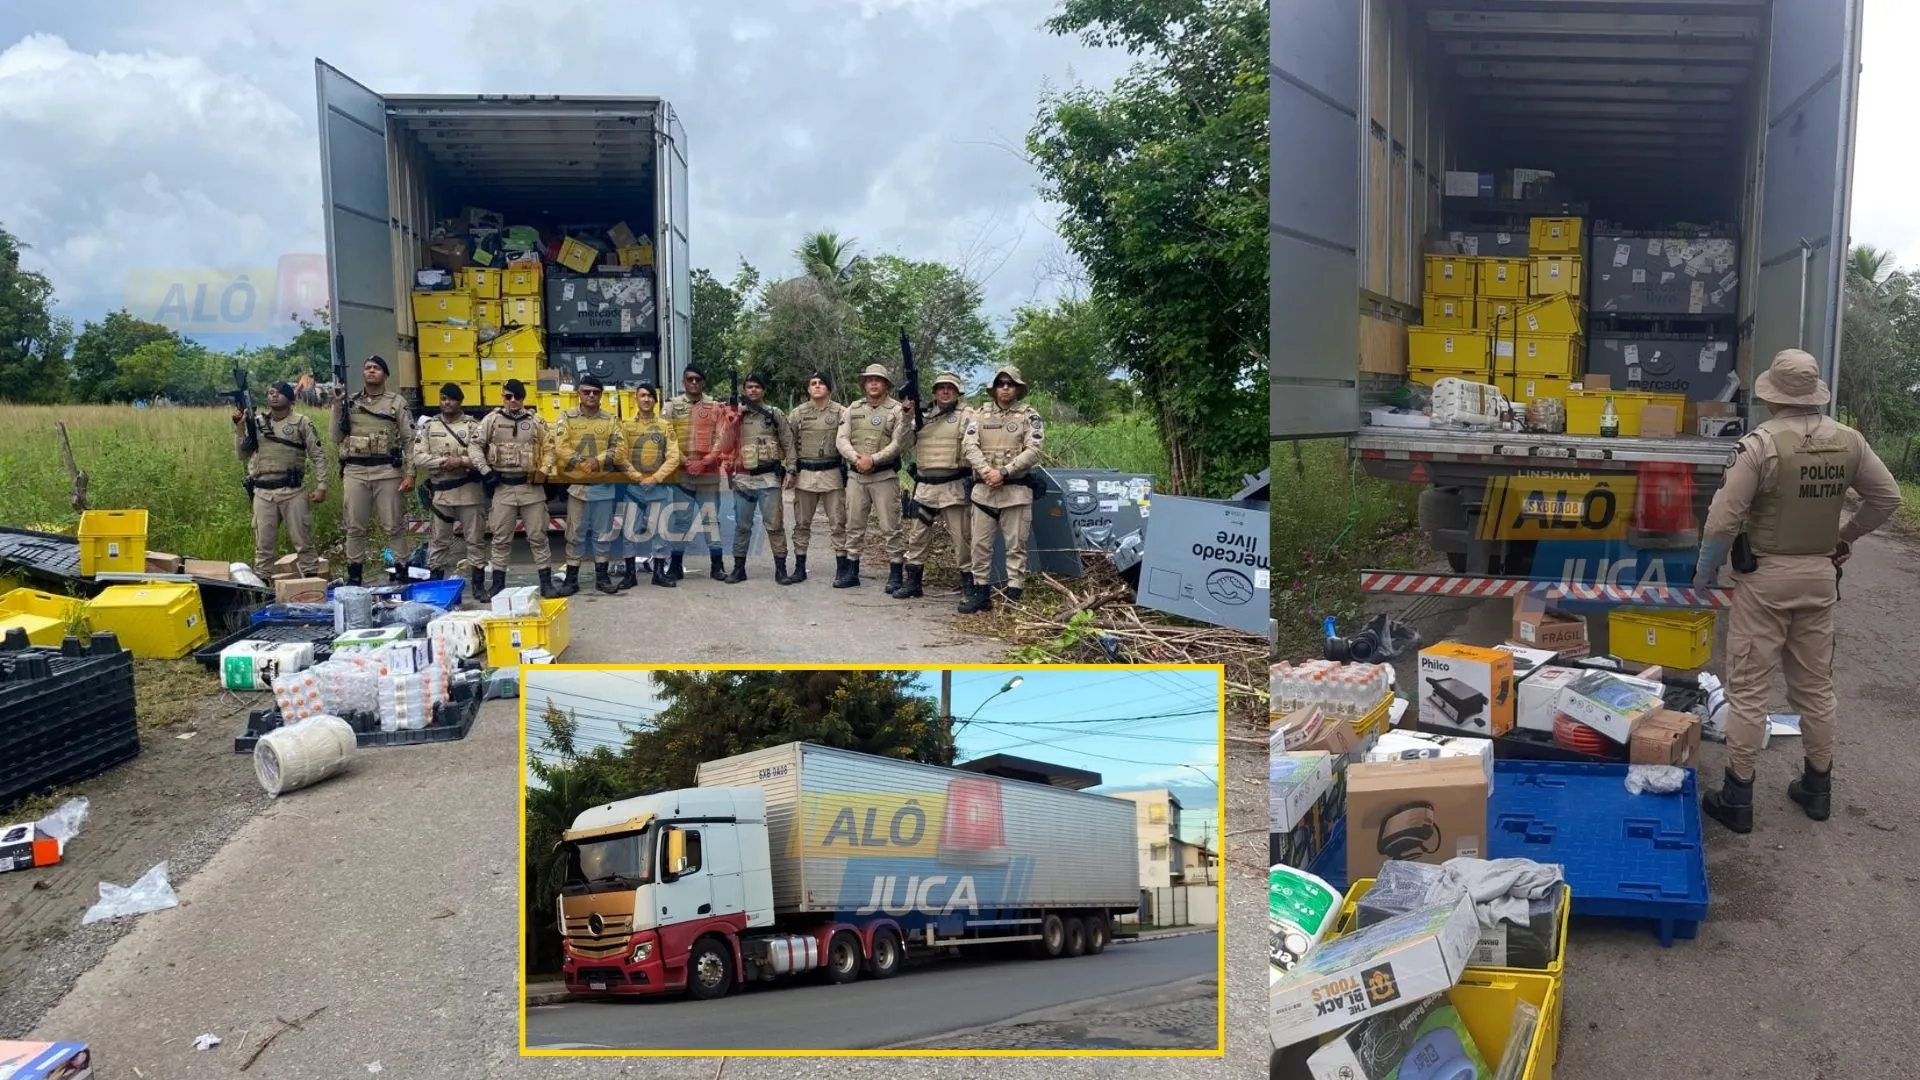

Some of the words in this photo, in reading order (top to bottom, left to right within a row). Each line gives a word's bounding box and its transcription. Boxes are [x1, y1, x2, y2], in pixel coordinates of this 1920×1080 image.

[1800, 463, 1845, 480] POLÍCIA
[1799, 484, 1843, 498] MILITAR
[1216, 530, 1258, 553] livre
[1541, 631, 1582, 645] FRÁGIL
[1421, 657, 1450, 671] Philco
[1311, 975, 1361, 1002] TOOLS
[1316, 989, 1364, 1017] BLACK
[1349, 1002, 1368, 1016] THE
